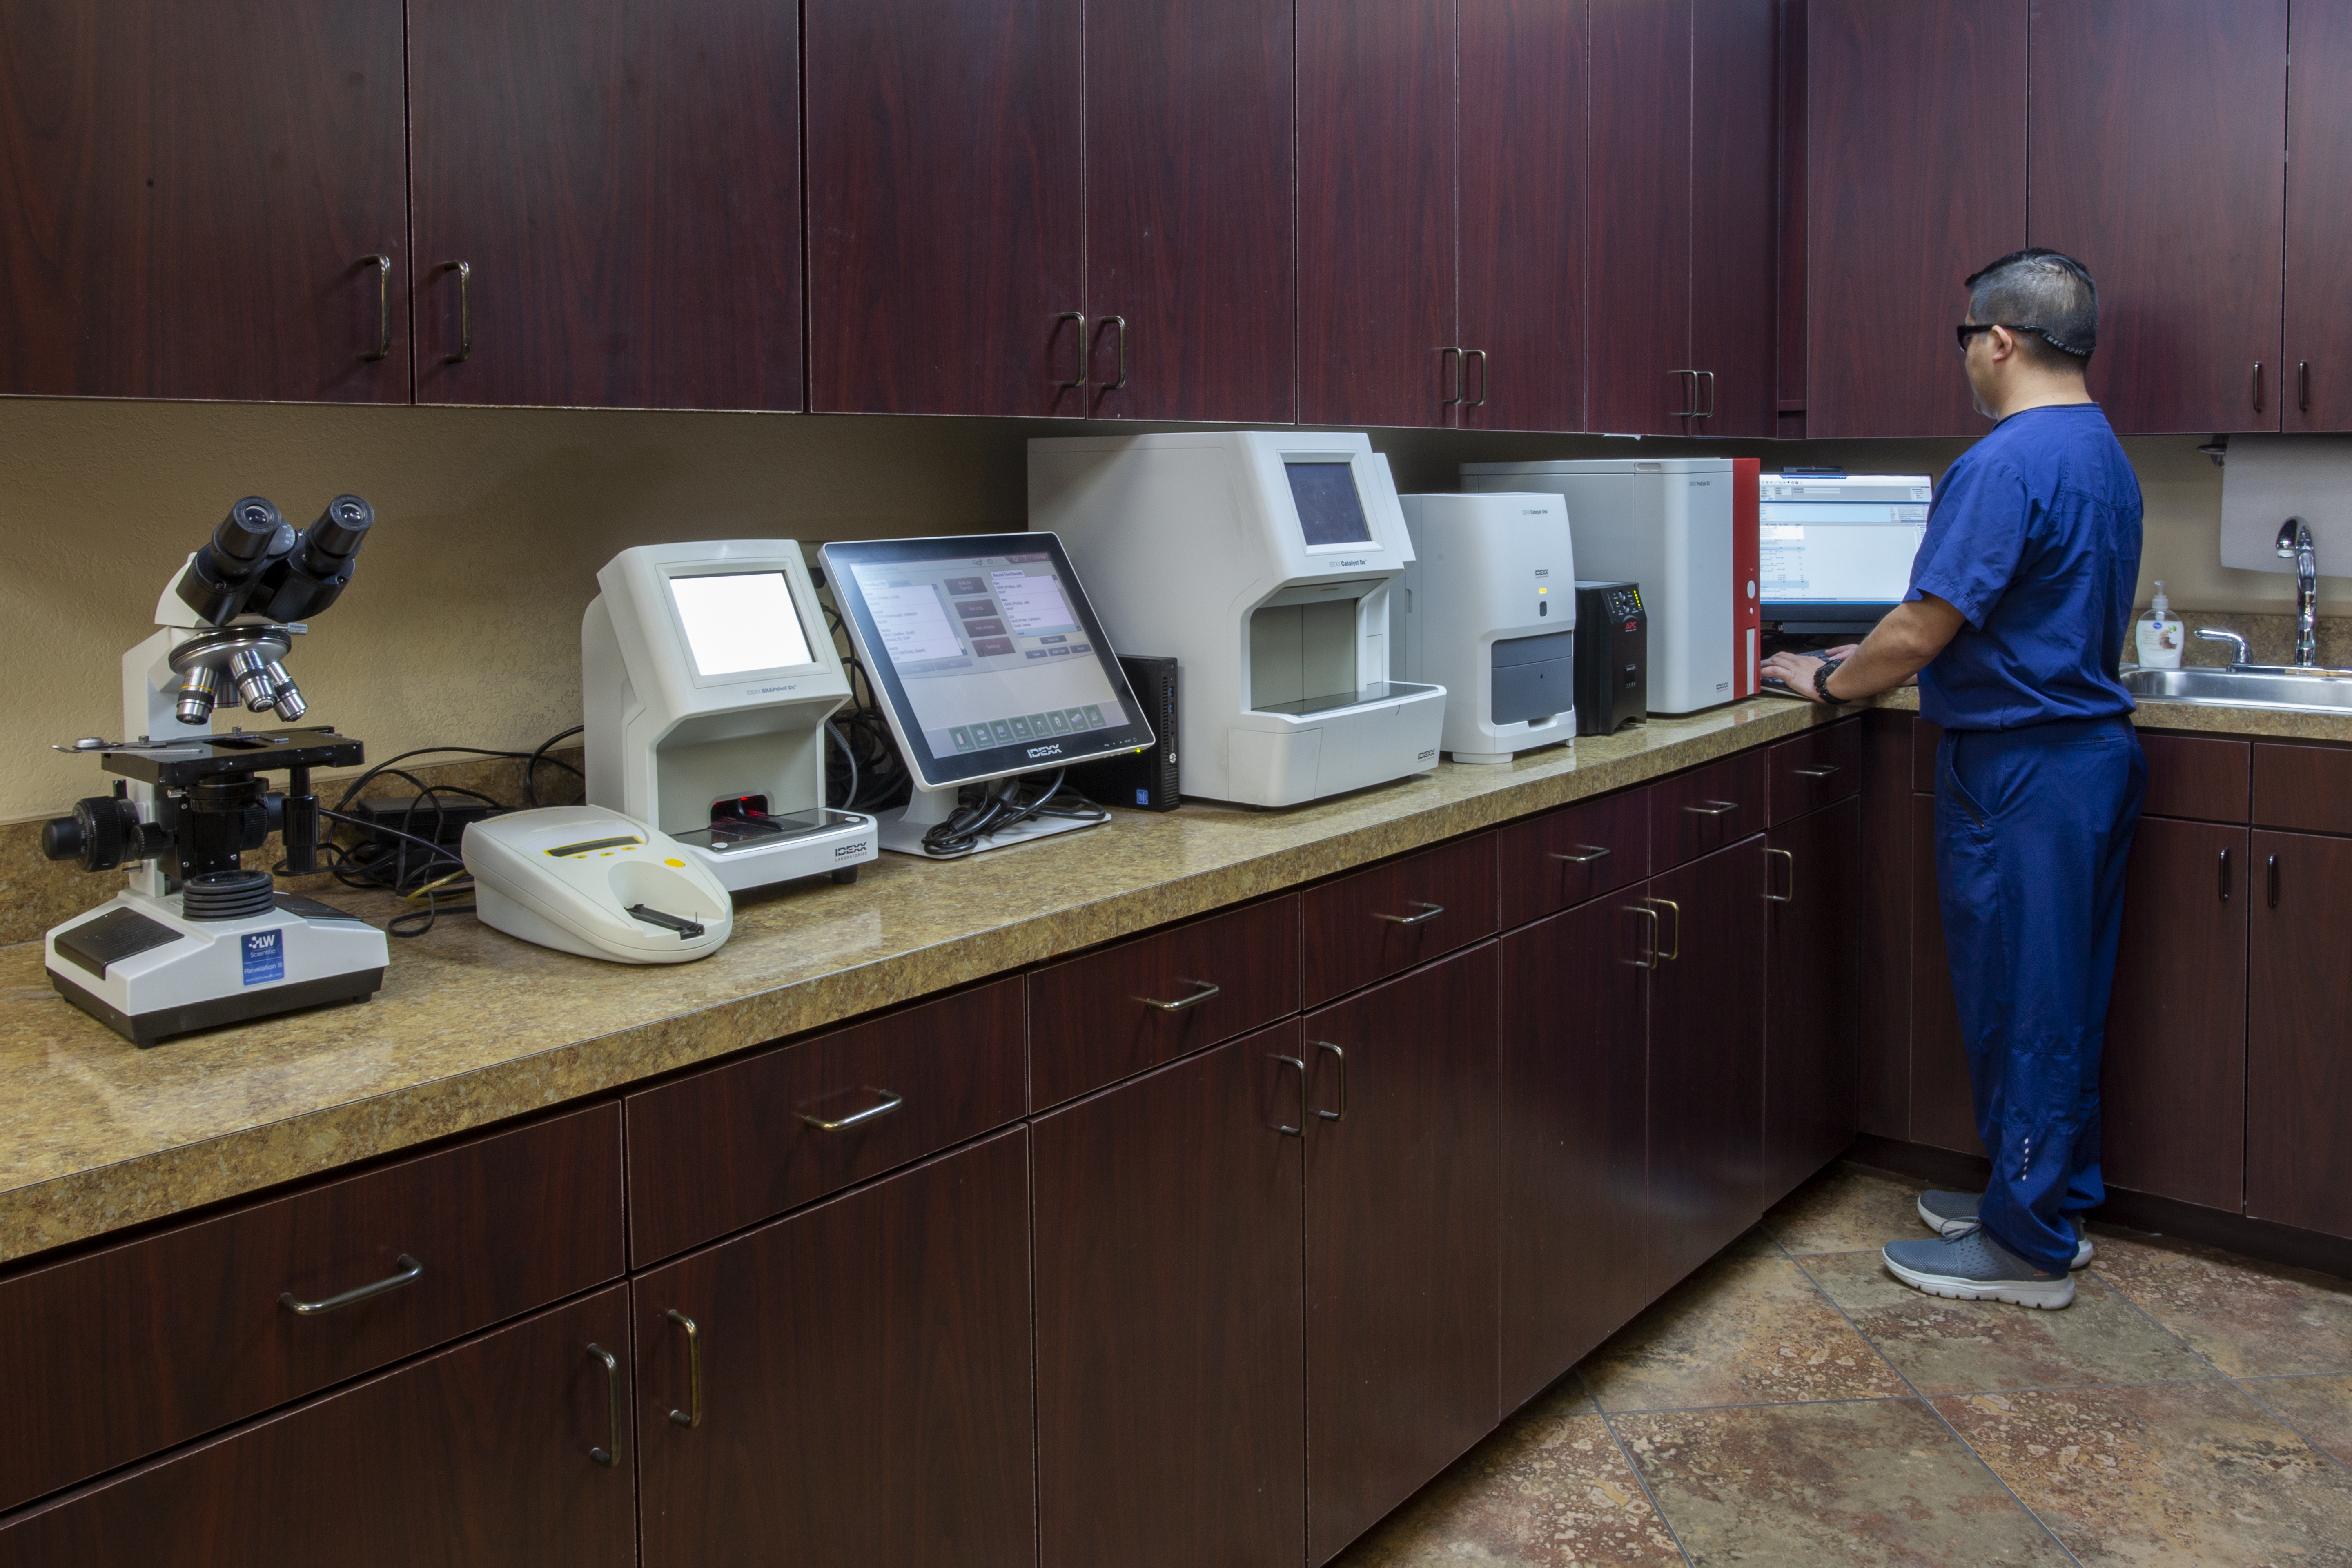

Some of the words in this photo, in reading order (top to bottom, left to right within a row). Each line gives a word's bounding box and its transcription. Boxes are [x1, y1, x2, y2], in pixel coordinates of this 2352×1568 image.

[2047, 336, 2064, 347] REC
[2065, 346, 2086, 355] SPECS
[1716, 682, 1728, 690] IDEXX
[1027, 744, 1062, 758] IDEXX
[1418, 748, 1435, 760] IDEXX
[1170, 754, 1176, 762] hp
[835, 842, 867, 857] IDEXX
[835, 851, 867, 862] LABORATORIES
[259, 934, 275, 948] LW
[250, 949, 276, 958] Scientific
[244, 964, 276, 974] Revelation
